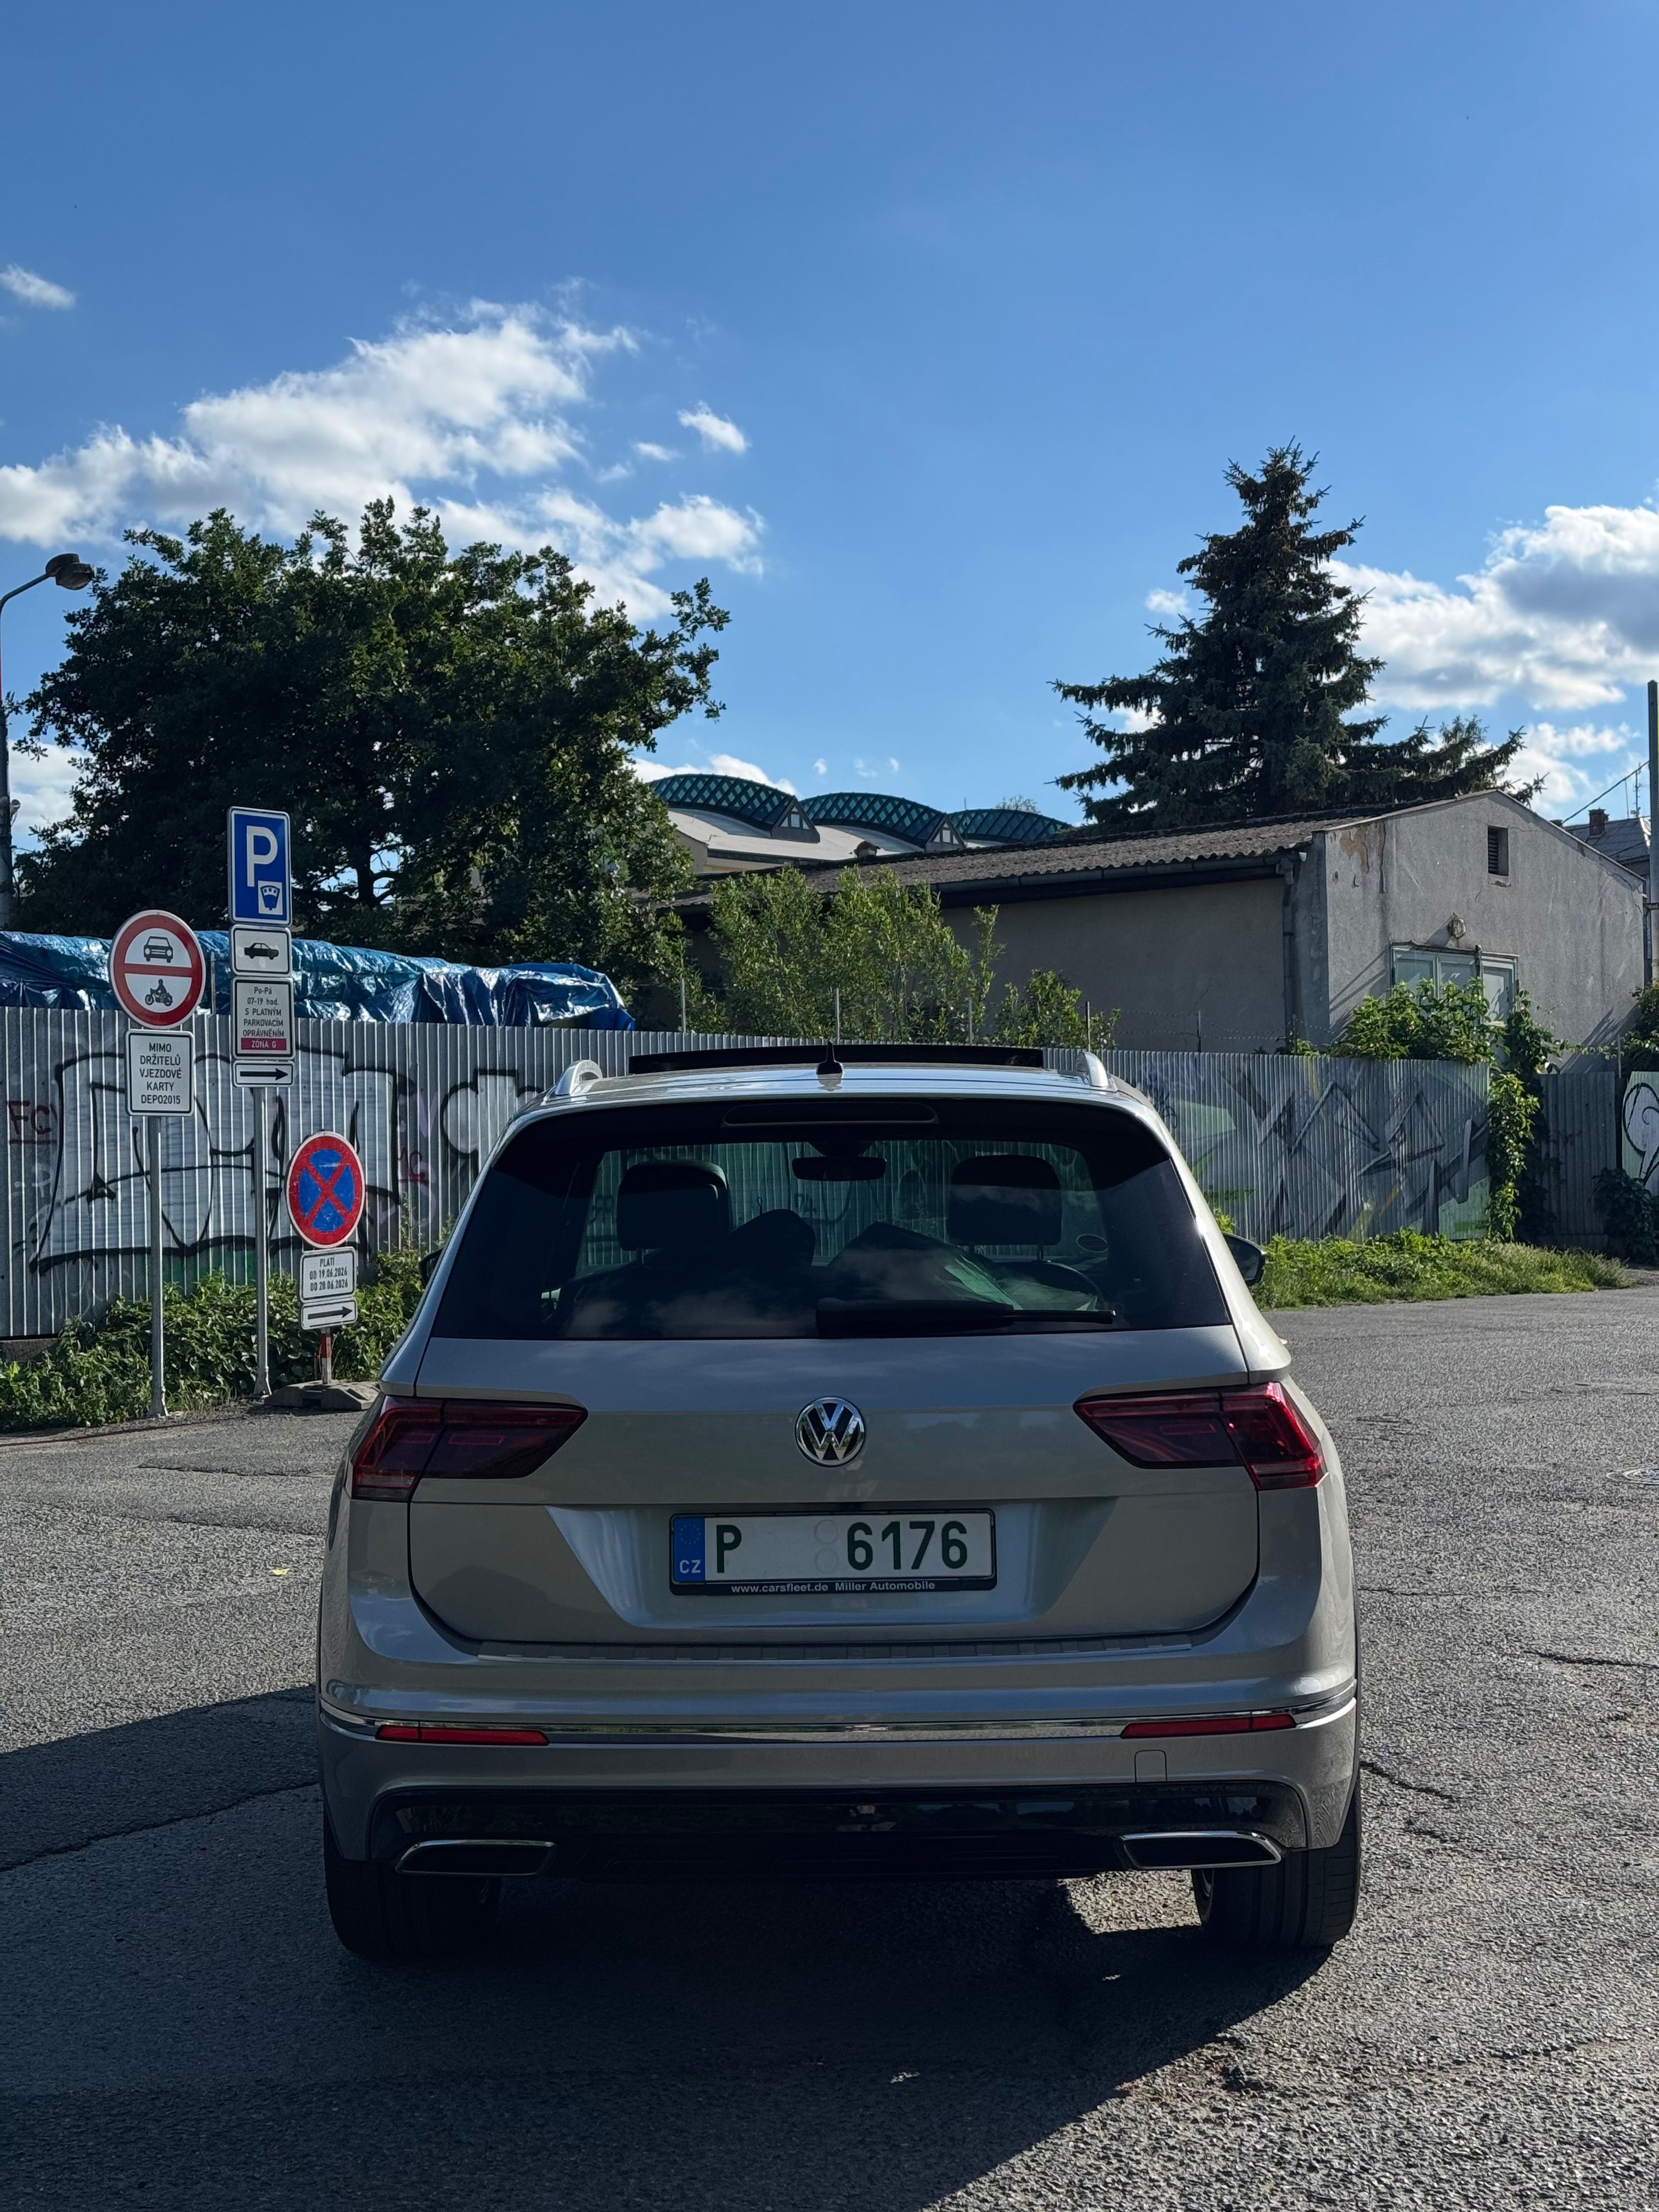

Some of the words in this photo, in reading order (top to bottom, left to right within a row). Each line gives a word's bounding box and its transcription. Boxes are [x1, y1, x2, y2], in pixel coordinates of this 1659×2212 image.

[246, 825, 278, 887] P
[252, 1007, 281, 1016] PLATNÝM
[244, 1018, 284, 1026] PARKOVACÍM
[242, 1028, 285, 1037] OPRÁVNĚNÍM
[149, 1042, 172, 1052] MIMO
[251, 1039, 269, 1048] ZÓNA
[140, 1053, 181, 1066] DRŽITELŮ
[139, 1067, 182, 1079] VJEZDOVÉ
[146, 1081, 174, 1091] KARTY
[141, 1094, 181, 1104] DEPO2015
[320, 1256, 335, 1267] PLATÍ
[309, 1271, 317, 1280] OD
[310, 1282, 318, 1291] DO
[716, 1525, 742, 1573] P
[847, 1521, 968, 1571] 6176
[679, 1559, 701, 1574] CZ
[731, 1583, 828, 1593] www.carsfleet.de
[835, 1582, 866, 1591] Miller
[870, 1581, 935, 1590] Automobile
